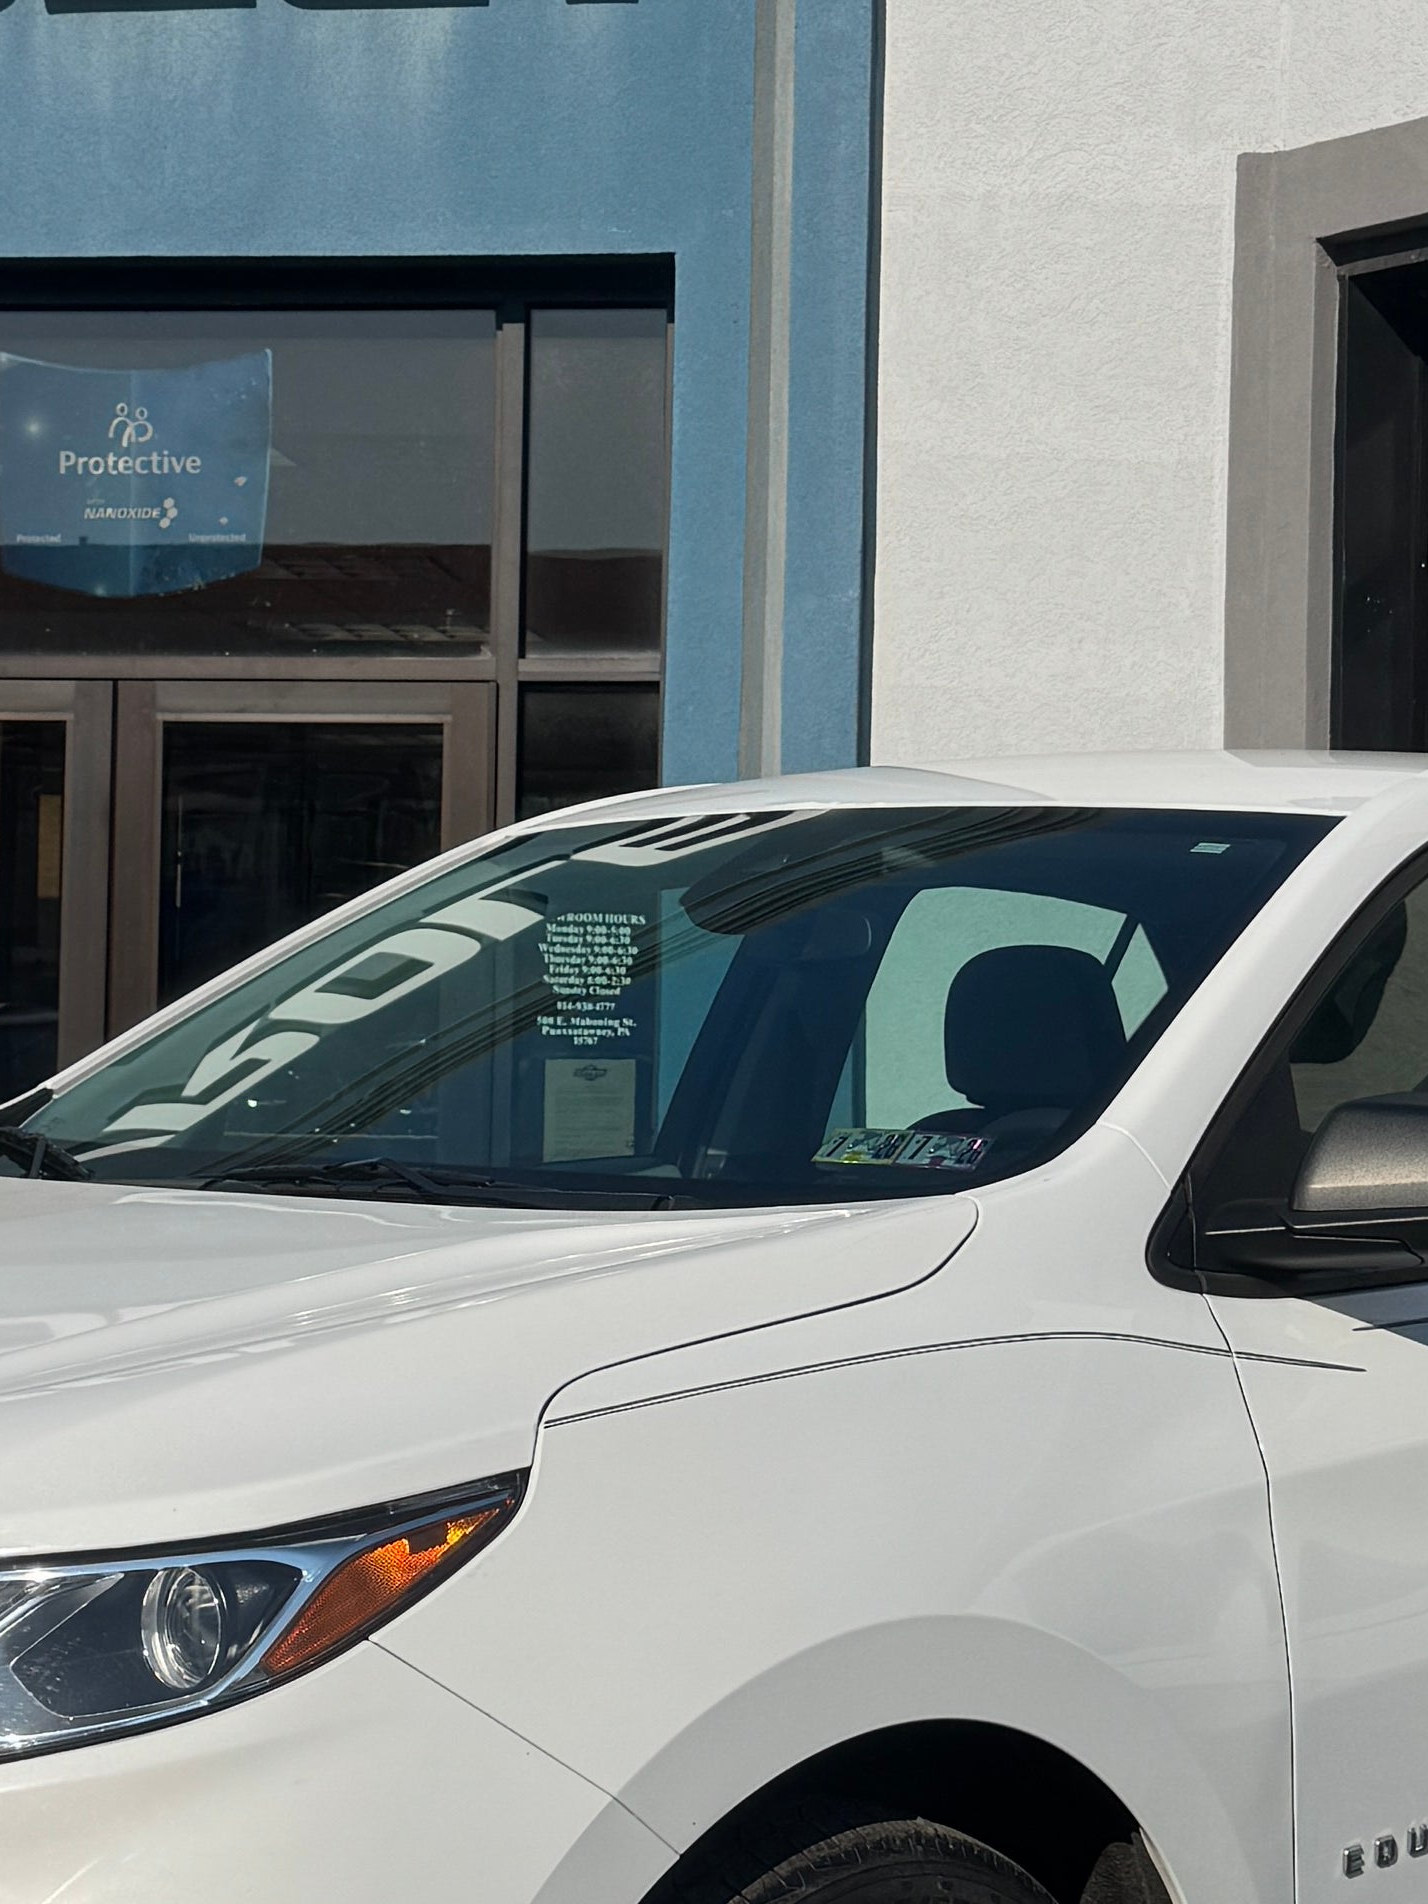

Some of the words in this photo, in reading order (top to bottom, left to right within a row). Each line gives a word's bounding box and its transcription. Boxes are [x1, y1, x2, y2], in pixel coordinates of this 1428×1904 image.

[59, 450, 202, 476] Protective
[83, 507, 162, 520] NANOXIDE
[16, 533, 62, 544] Protected
[605, 913, 647, 926] HOURS
[549, 964, 579, 976] Friday
[588, 985, 621, 996] Closed
